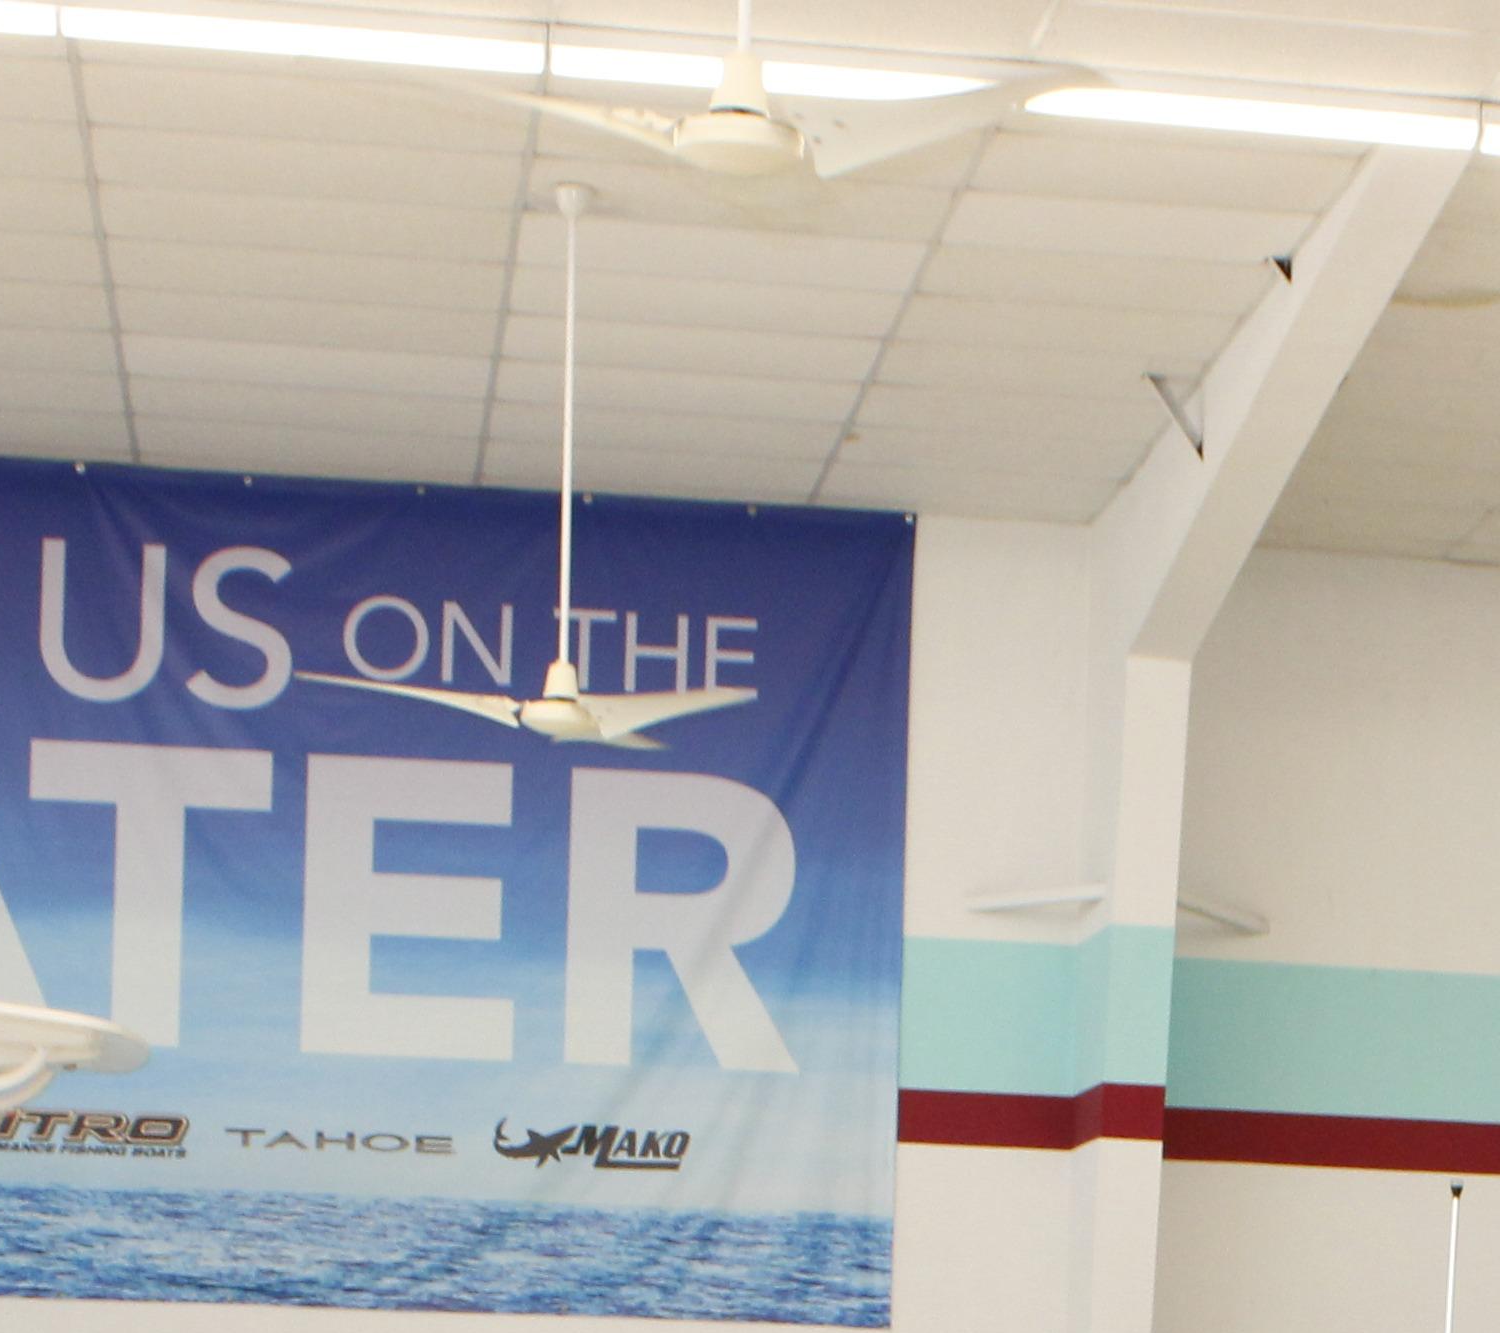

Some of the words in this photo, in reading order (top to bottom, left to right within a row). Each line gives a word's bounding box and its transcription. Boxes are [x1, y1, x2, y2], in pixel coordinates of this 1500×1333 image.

[41, 537, 296, 710] US
[343, 595, 514, 686] ON
[554, 607, 758, 695] THE
[225, 1127, 456, 1155] TAHOE
[562, 1123, 691, 1171] MAKO
